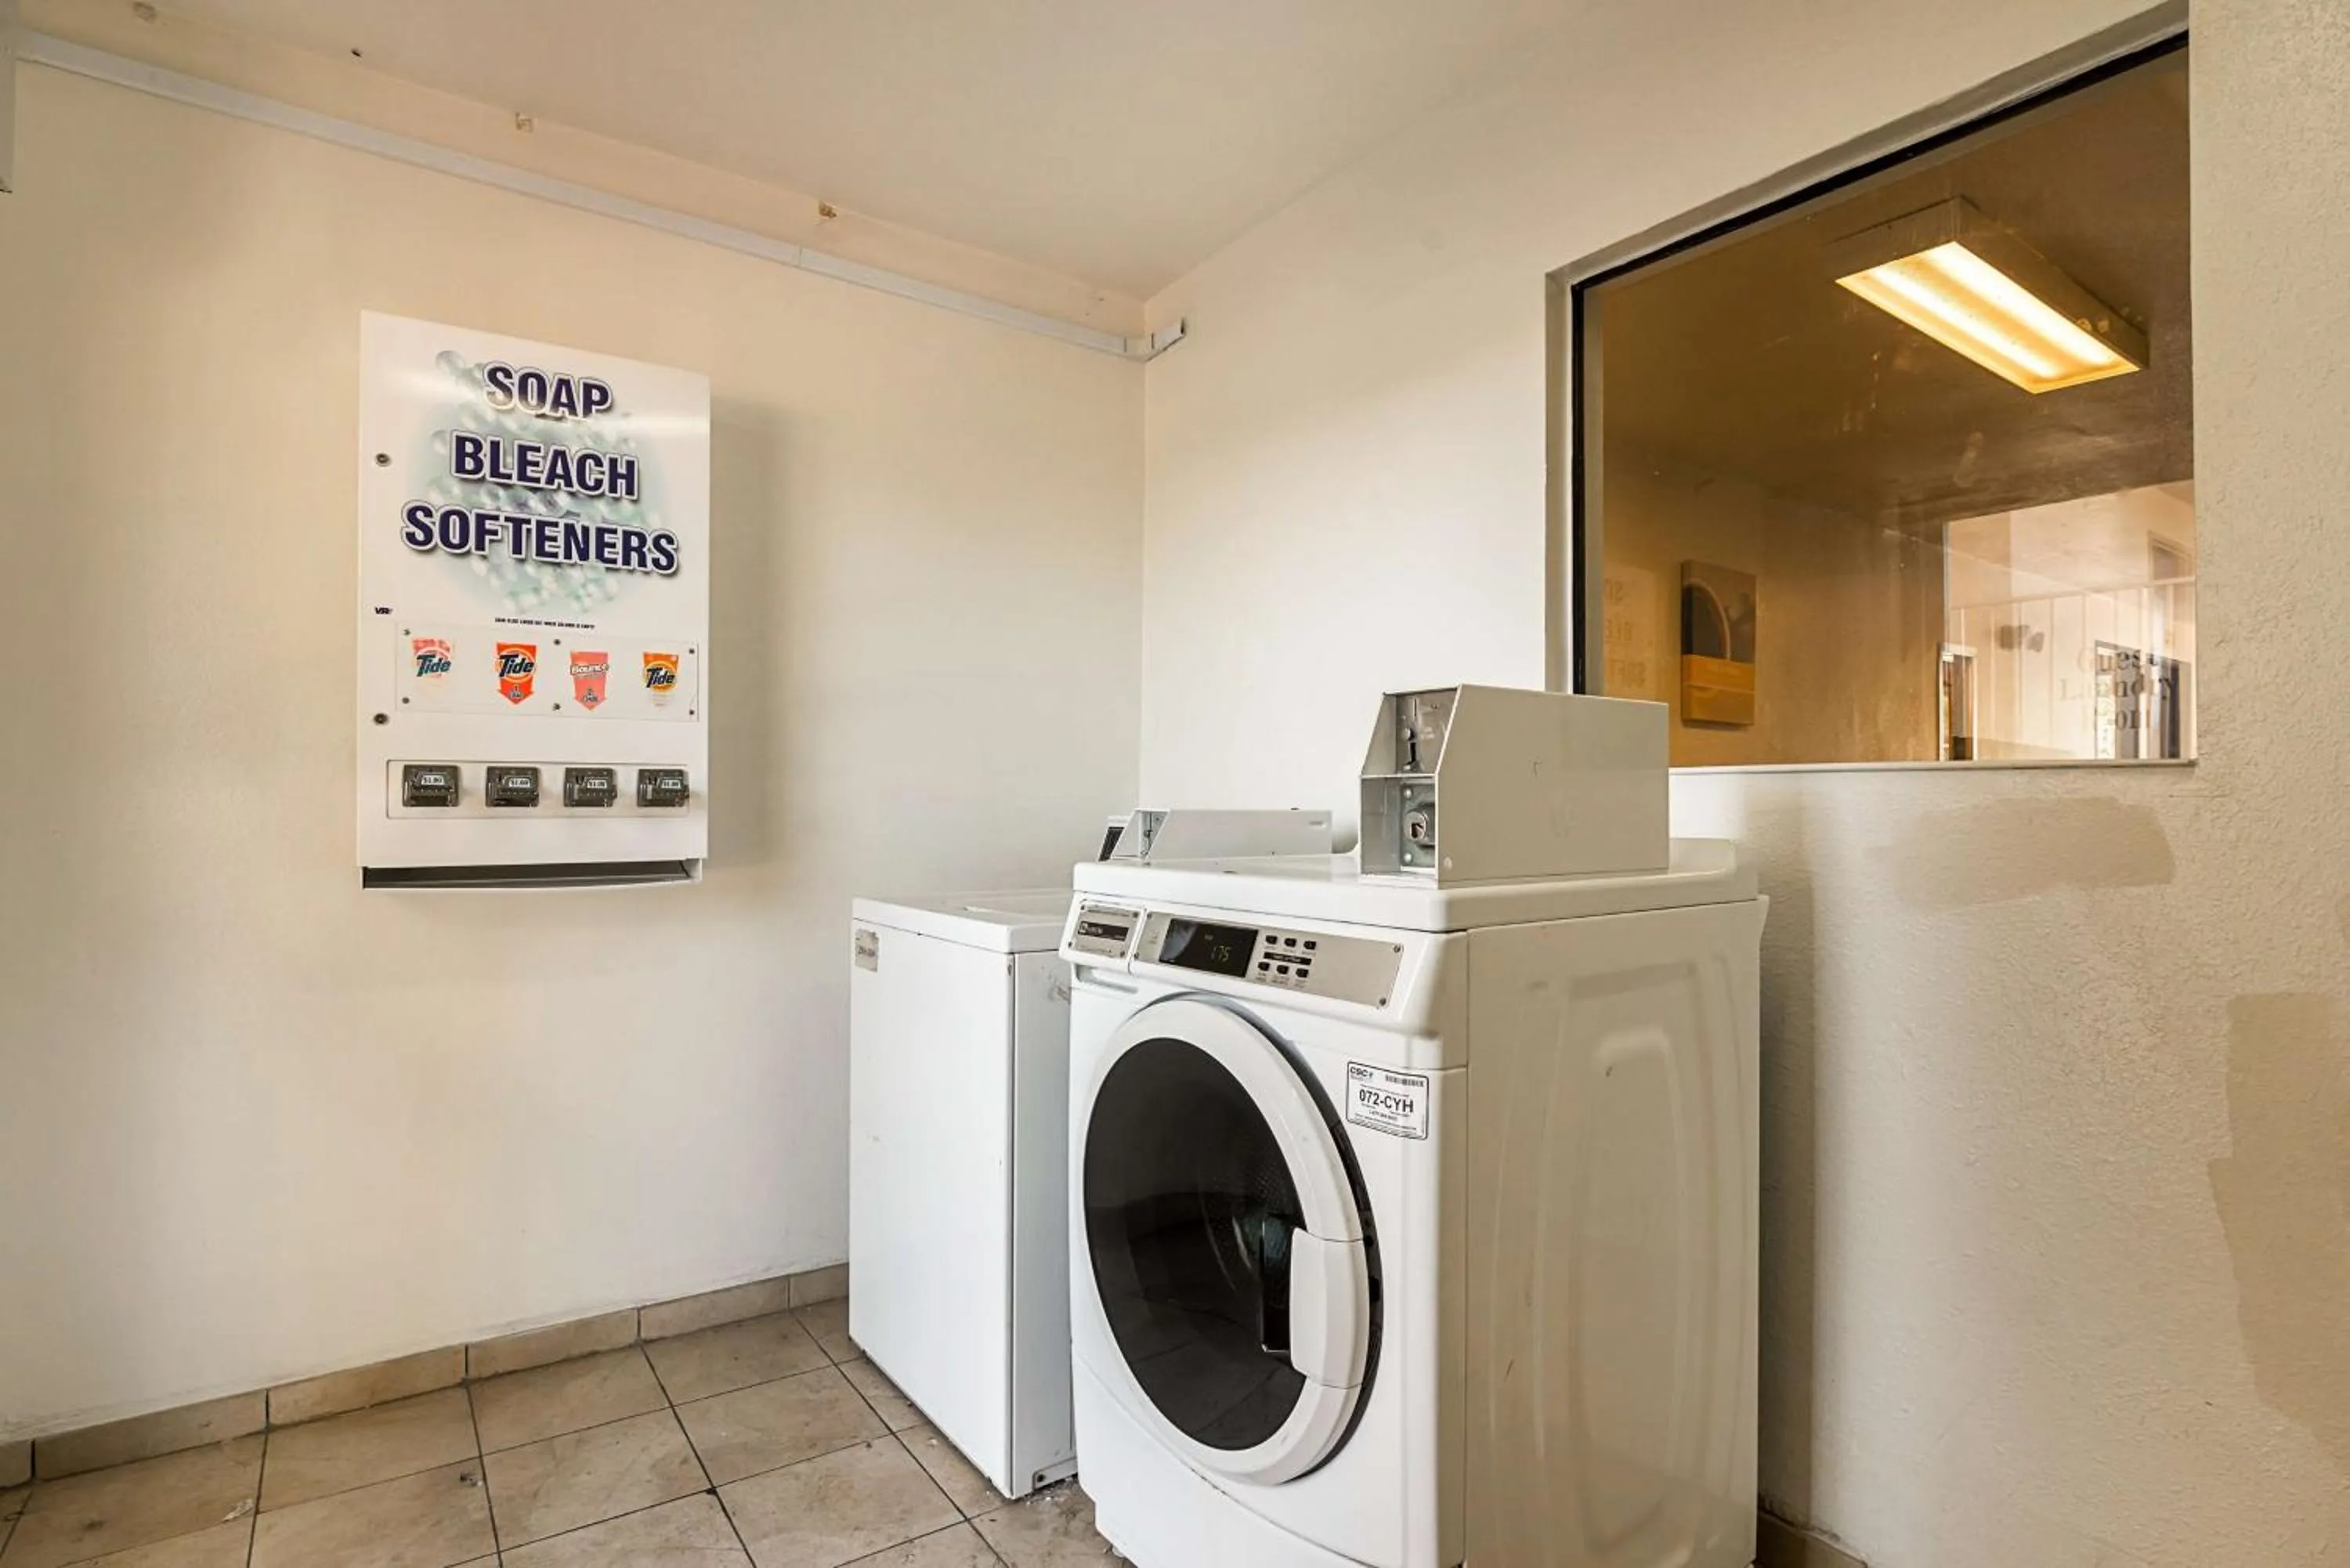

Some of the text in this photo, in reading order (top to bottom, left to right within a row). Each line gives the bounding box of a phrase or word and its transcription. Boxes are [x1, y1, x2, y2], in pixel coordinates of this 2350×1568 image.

[483, 363, 613, 419] SOAP
[451, 431, 638, 500] BLEACH
[402, 501, 678, 574] SOFTENERS
[416, 654, 452, 677] Tide
[499, 654, 535, 677] Tide
[645, 667, 675, 688] Tide
[1359, 1089, 1413, 1113] 072-CYH
